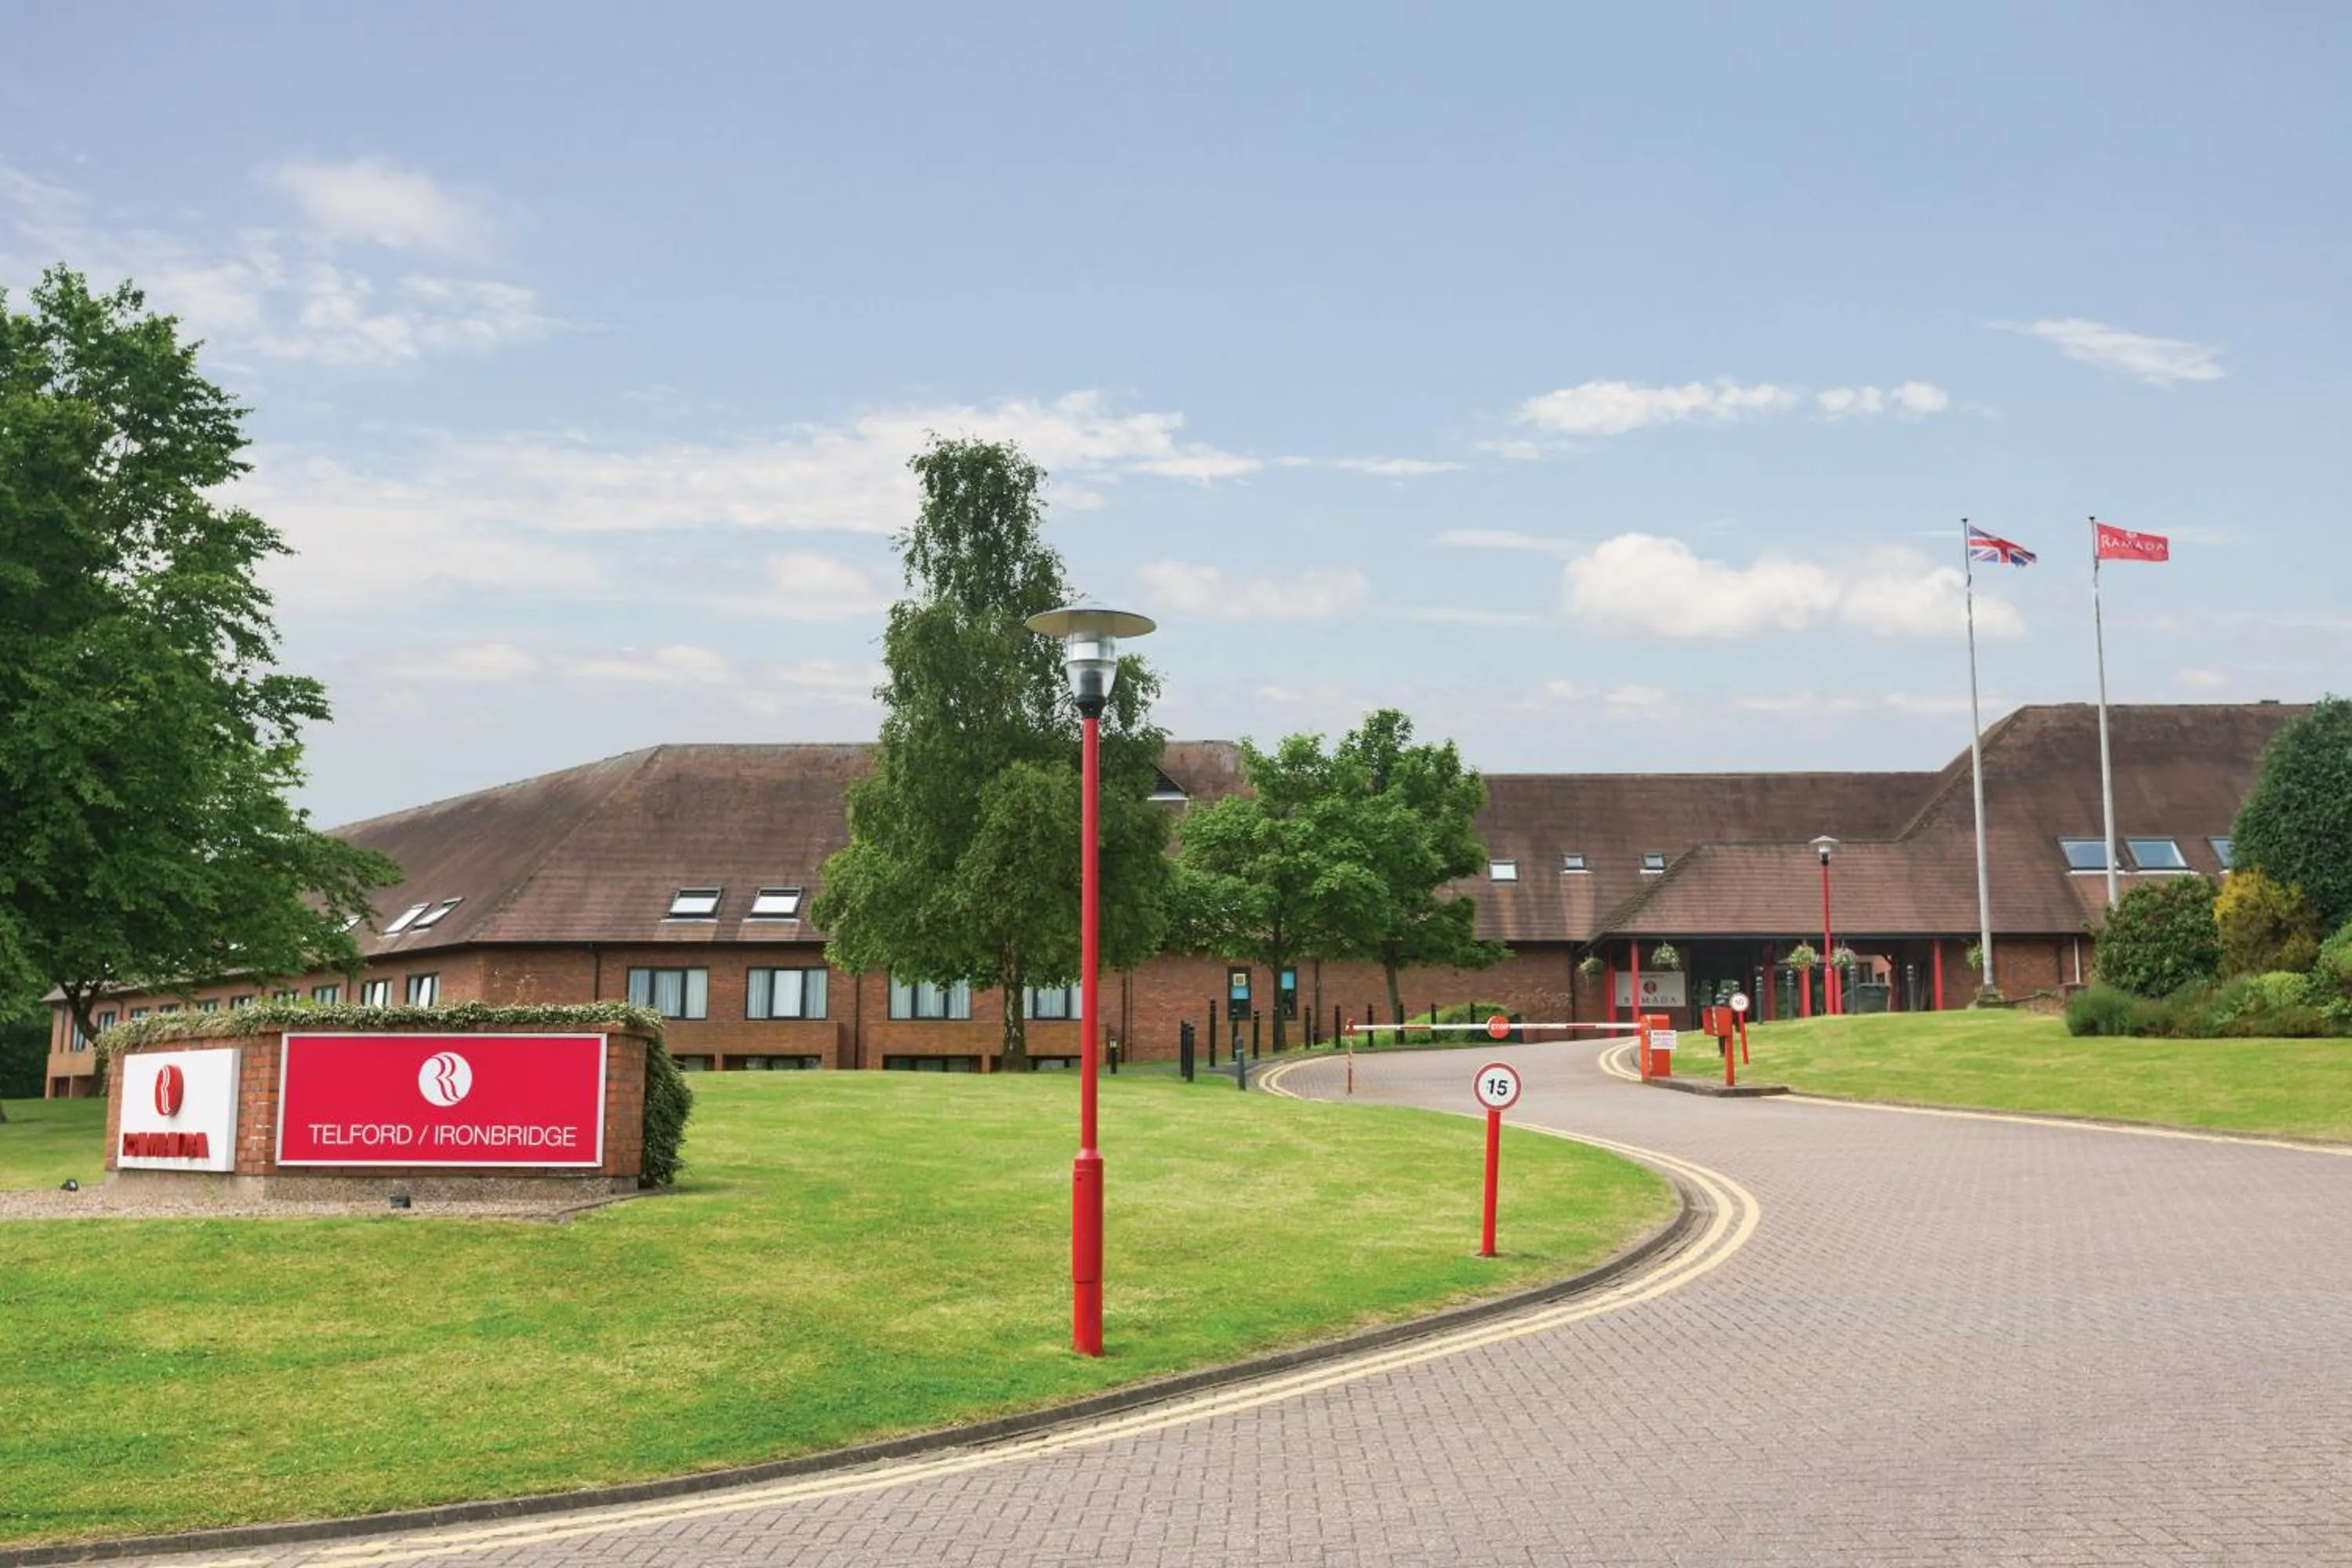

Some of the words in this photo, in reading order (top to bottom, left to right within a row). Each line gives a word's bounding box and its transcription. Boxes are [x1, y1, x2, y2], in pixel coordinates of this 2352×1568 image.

[2101, 535, 2165, 550] RAMADA
[1487, 1078, 1508, 1096] 15
[309, 1123, 412, 1145] TELFORD
[434, 1125, 578, 1146] IRONBRIDGE
